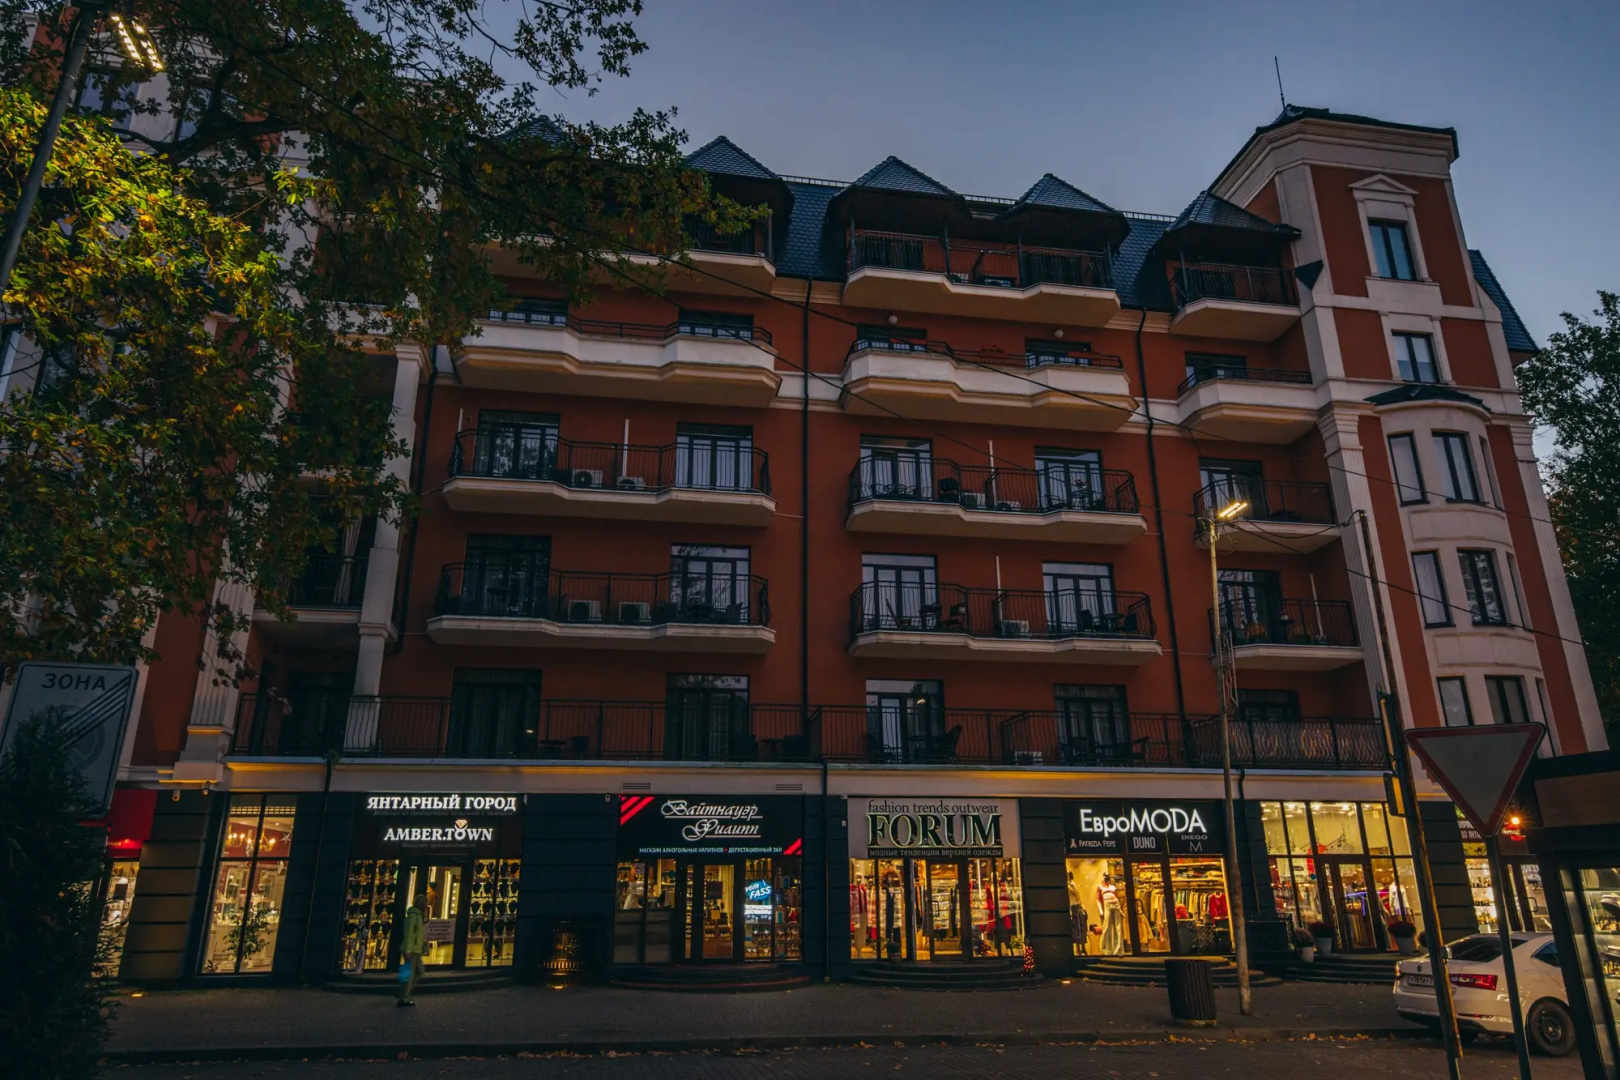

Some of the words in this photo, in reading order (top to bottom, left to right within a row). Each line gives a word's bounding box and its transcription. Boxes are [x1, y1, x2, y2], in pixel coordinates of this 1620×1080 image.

[42, 673, 106, 691] ЗОНА
[366, 794, 461, 810] ЯНТАРНЫЙ
[464, 796, 517, 812] ГОРОД
[660, 799, 758, 821] Вайтнауэр
[868, 800, 909, 813] fashion
[913, 800, 949, 813] trends
[951, 802, 999, 813] outwear
[383, 823, 494, 841] AMBER.TOWN
[682, 819, 760, 841] Филипп
[866, 813, 1003, 848] FORUM
[1078, 839, 1102, 848] PATRIZIA
[1103, 840, 1116, 848] PEPE
[1133, 836, 1156, 849] DUNO
[1189, 841, 1203, 852] M
[869, 849, 898, 857] модные
[900, 849, 940, 857] тенденции
[941, 848, 971, 859] верхней
[972, 848, 1002, 858] одежды
[749, 886, 772, 900] FASS
